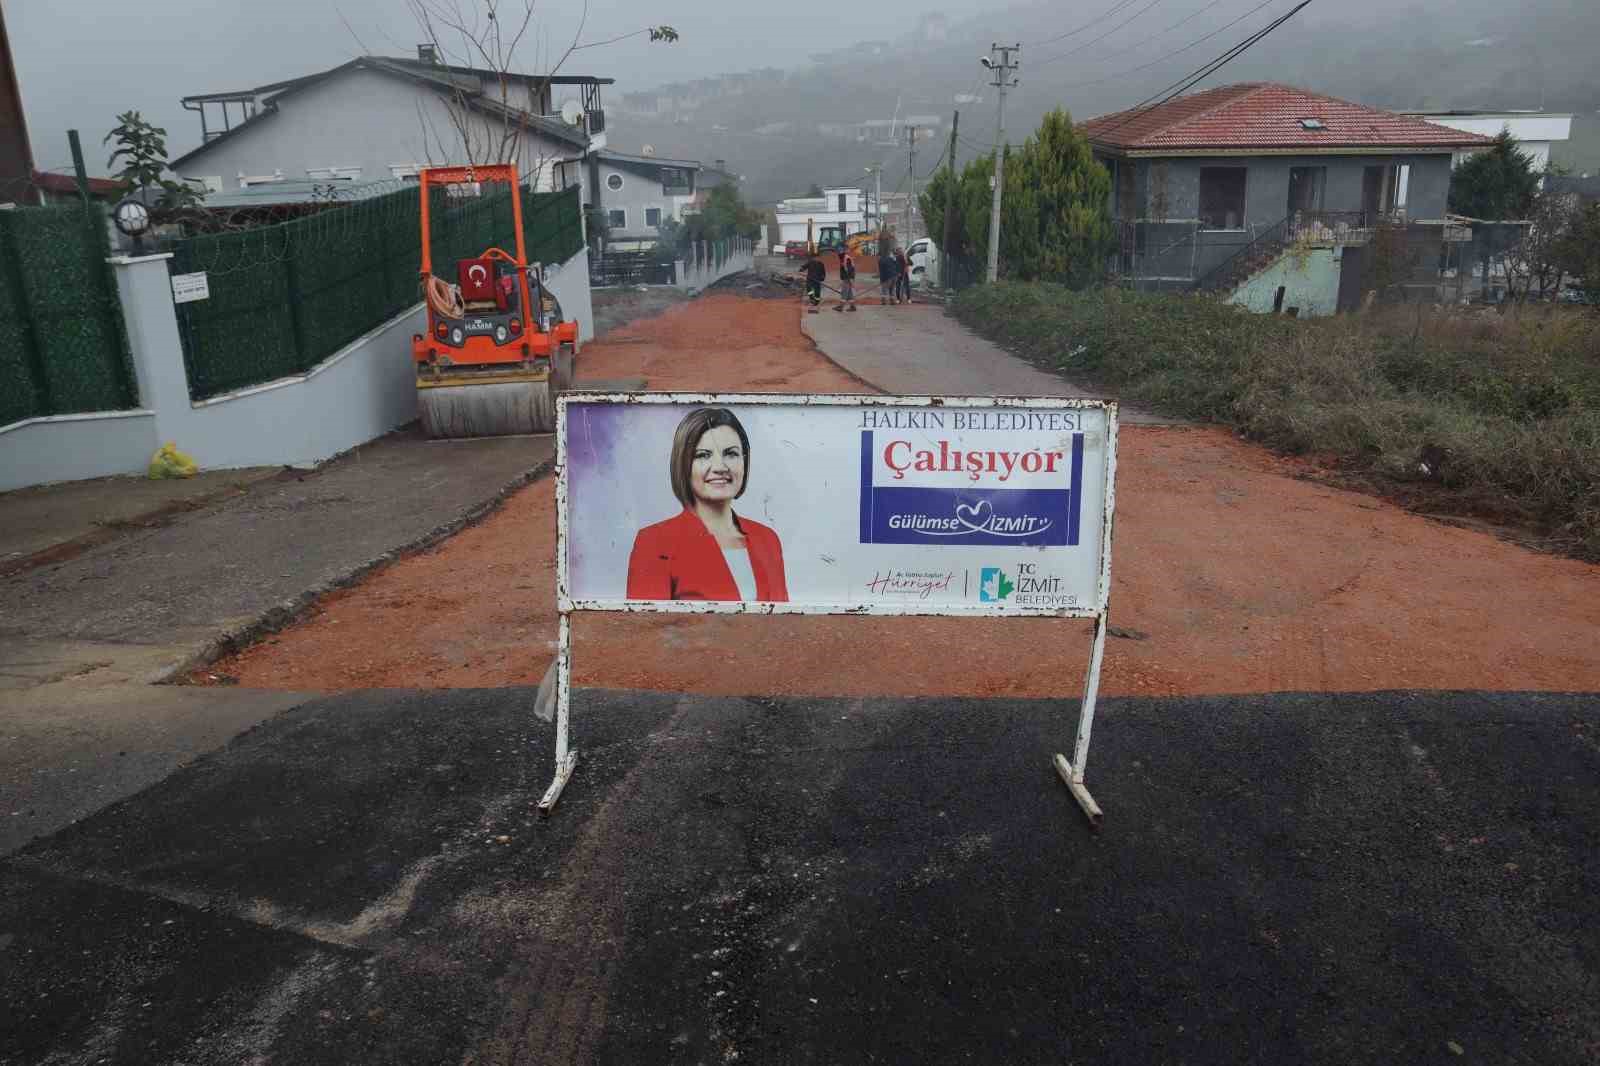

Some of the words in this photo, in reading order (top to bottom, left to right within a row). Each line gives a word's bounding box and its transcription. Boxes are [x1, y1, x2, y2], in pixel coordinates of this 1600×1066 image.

[862, 411, 944, 428] HALKIN
[953, 410, 1081, 431] BELEDİYESİ
[883, 440, 1063, 480] Çalışıyor
[888, 514, 959, 530] Gülümse
[990, 513, 1036, 531] İZMİT
[1017, 574, 1061, 593] İZMİT
[1015, 594, 1078, 605] BELEDİYESİ
